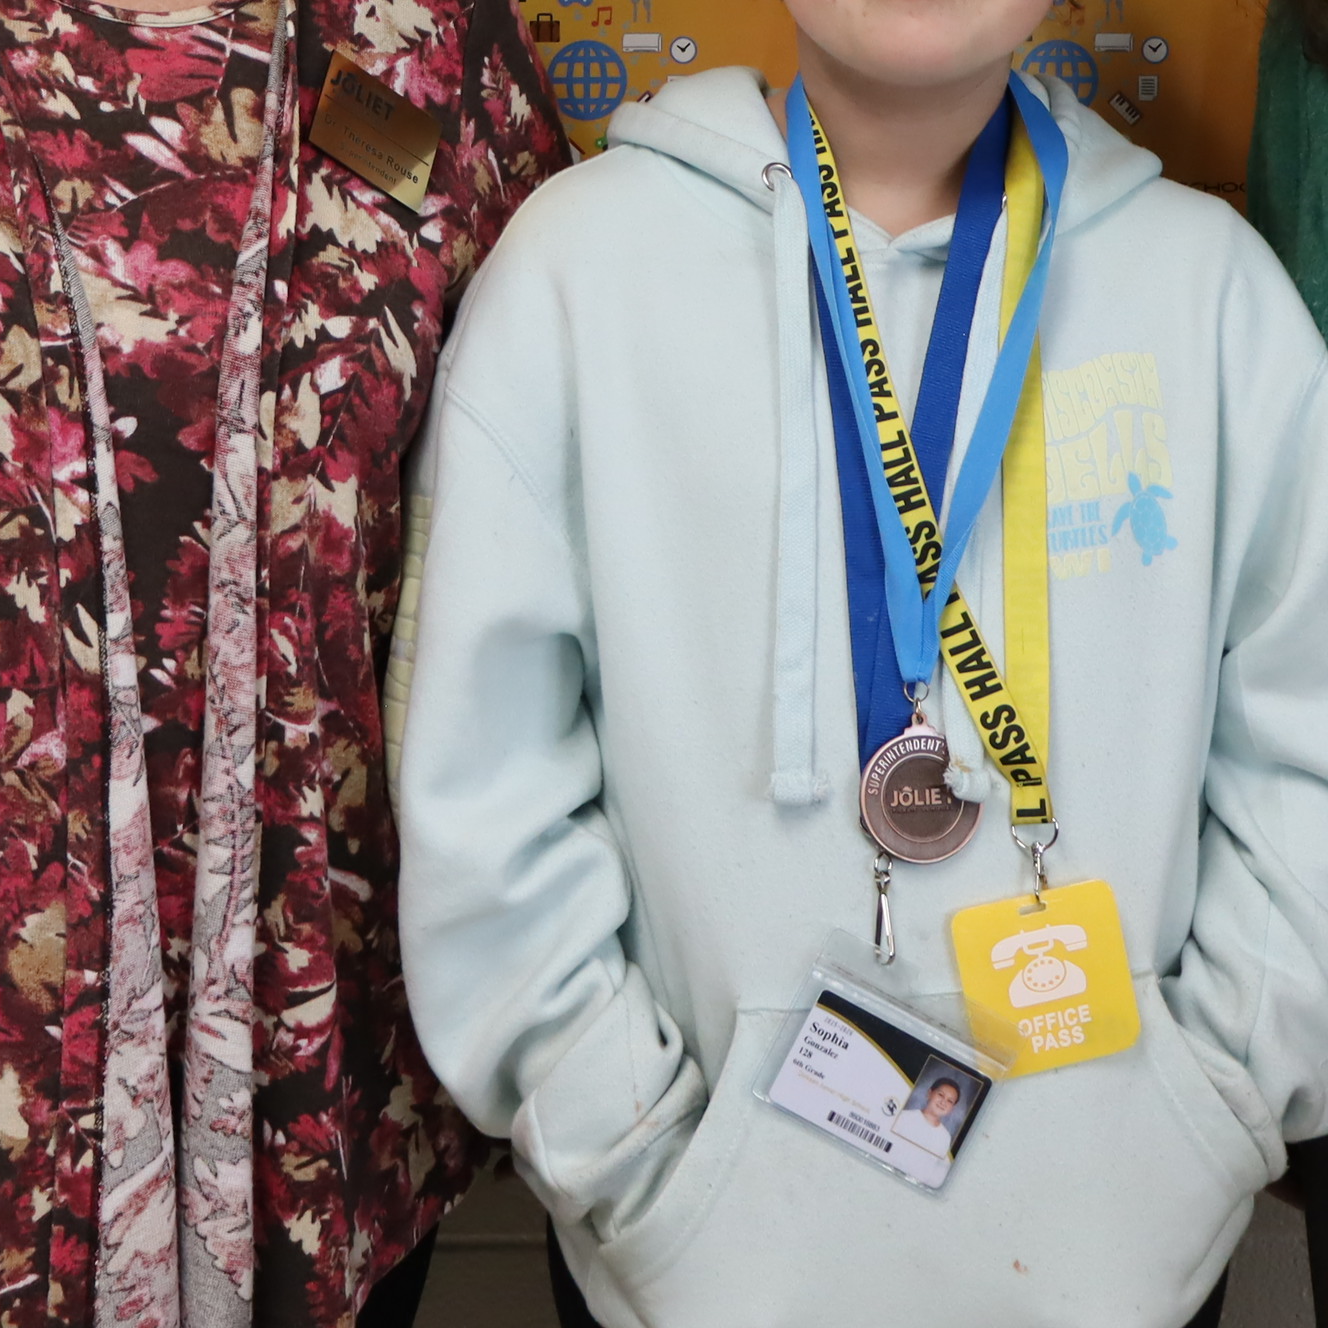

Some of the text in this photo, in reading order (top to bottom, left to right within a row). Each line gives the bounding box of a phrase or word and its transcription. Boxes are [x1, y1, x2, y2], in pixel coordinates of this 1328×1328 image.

[860, 338, 927, 516] HALL PASS
[940, 611, 1043, 788] PASS HALL
[810, 1021, 850, 1050] Sophia
[1017, 1004, 1092, 1038] OFFICE
[1032, 1025, 1086, 1054] PASS
